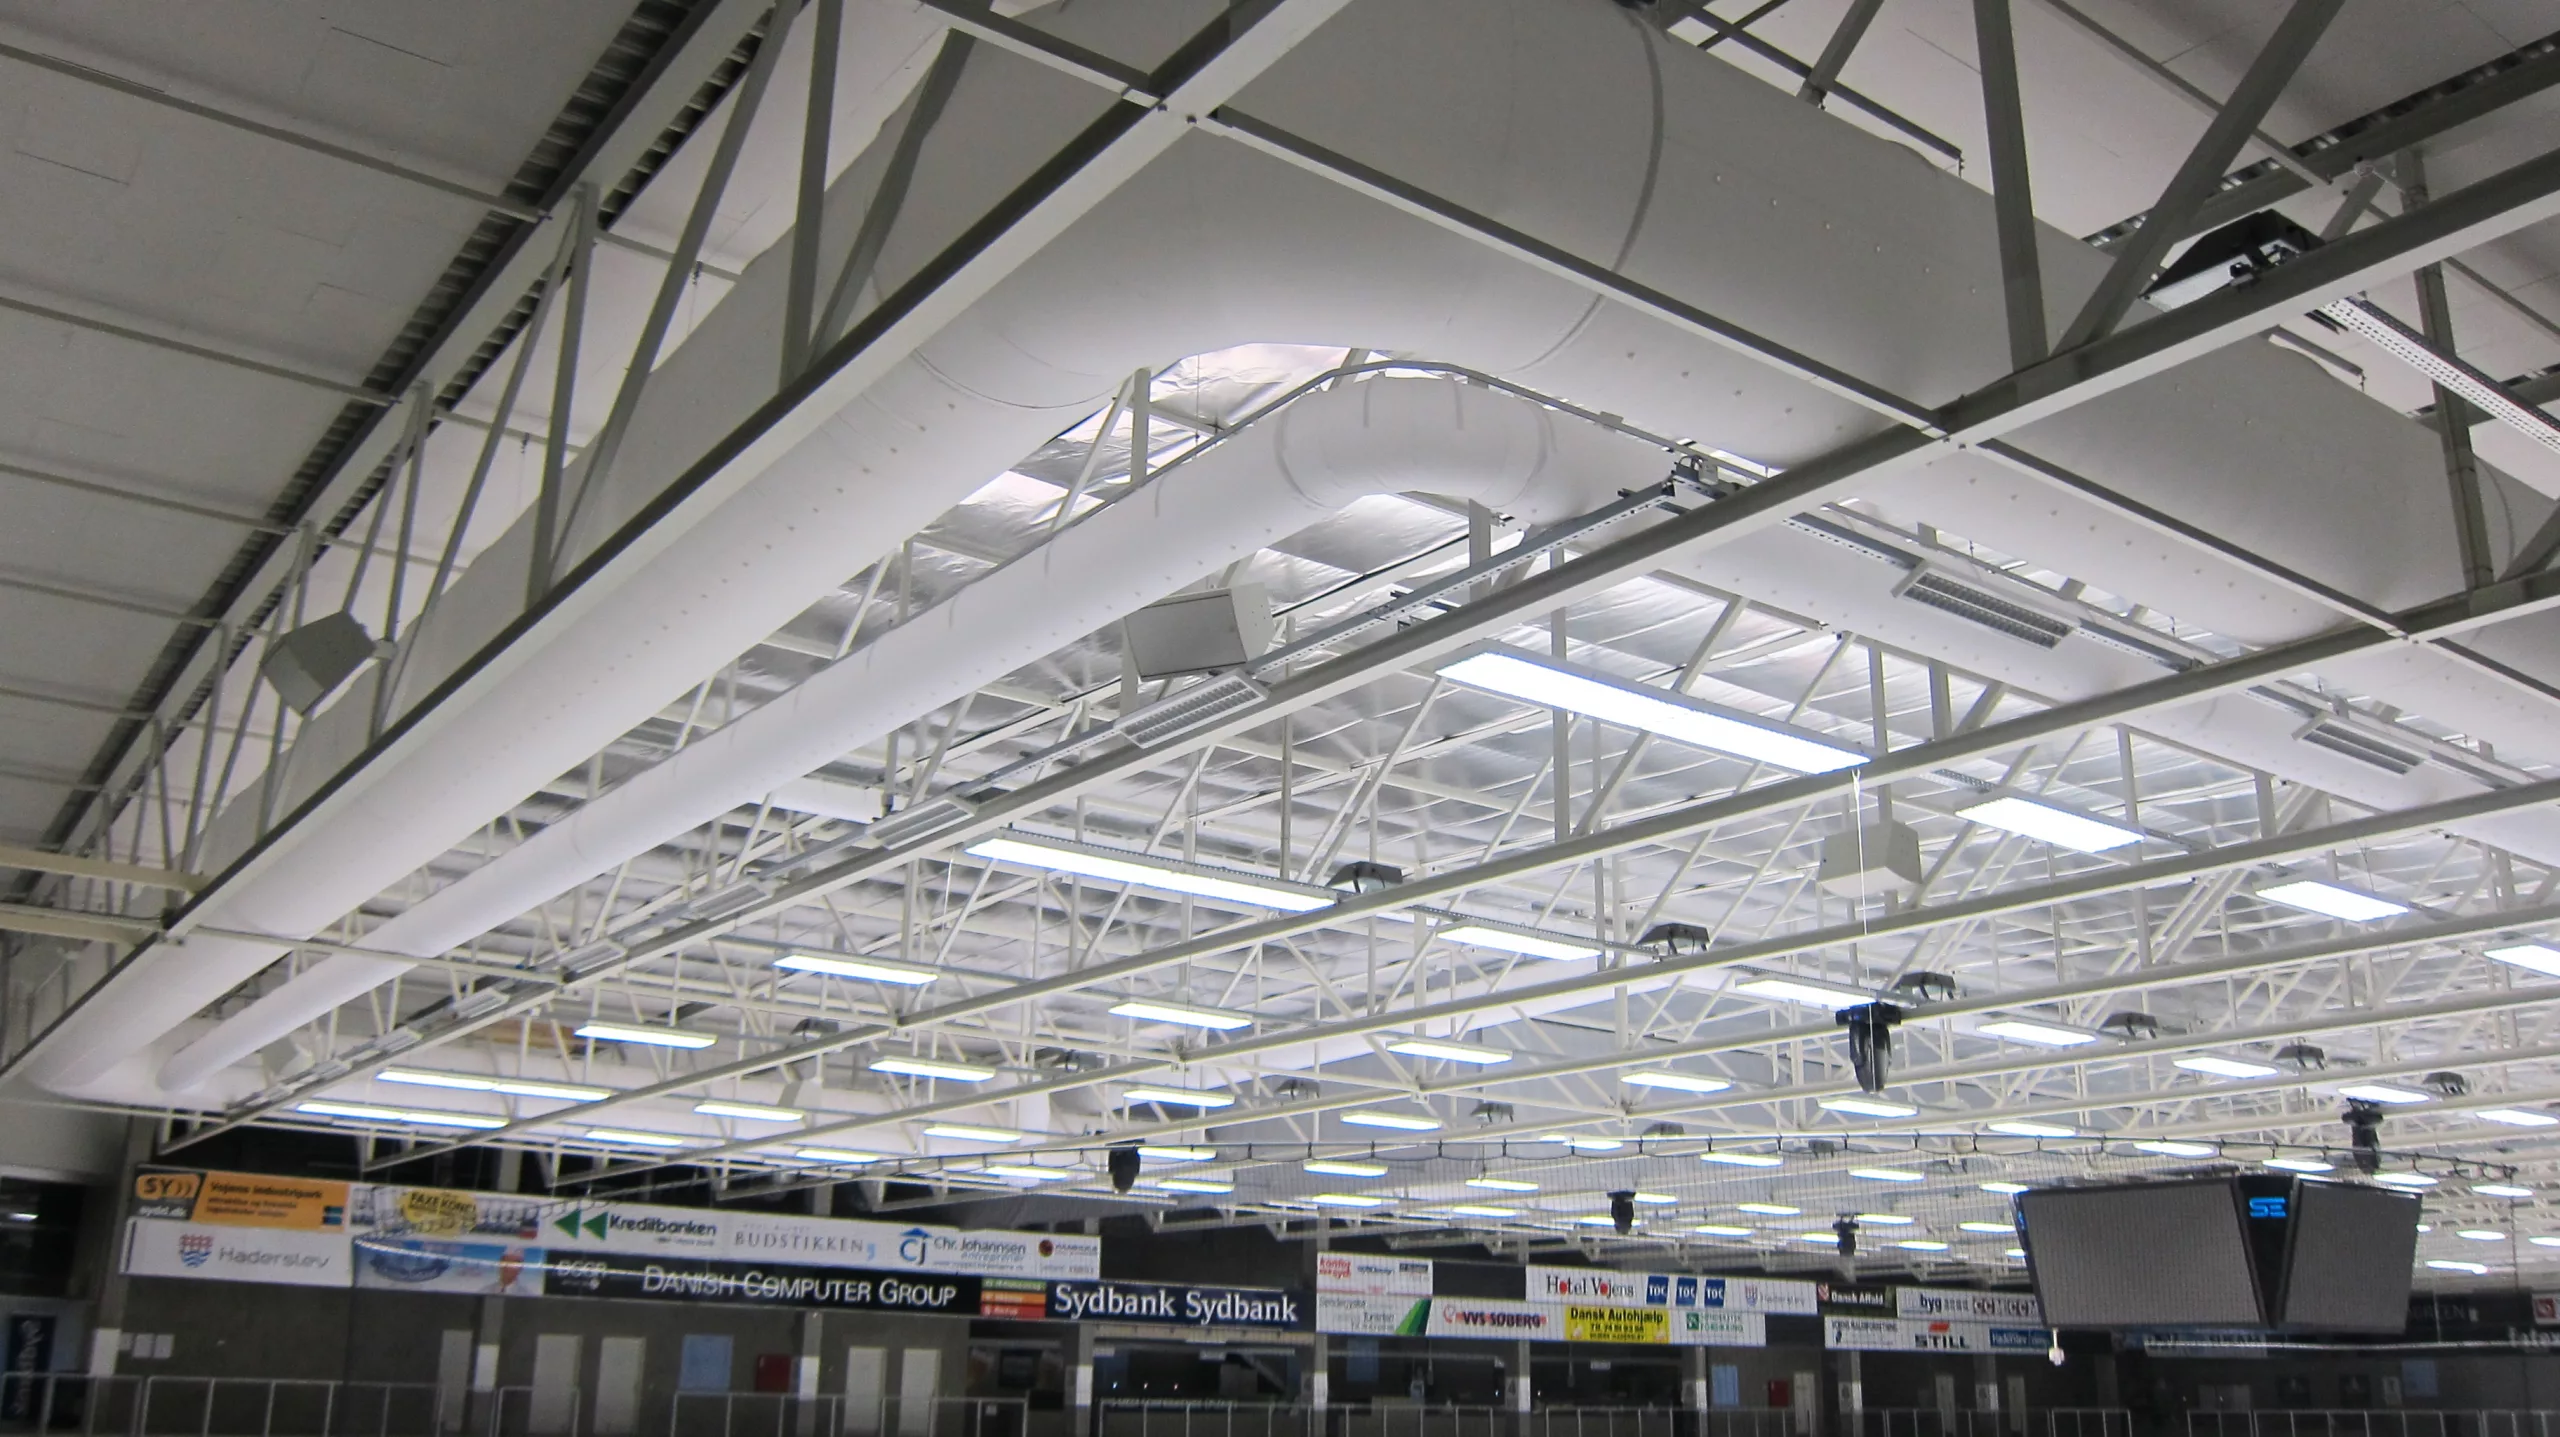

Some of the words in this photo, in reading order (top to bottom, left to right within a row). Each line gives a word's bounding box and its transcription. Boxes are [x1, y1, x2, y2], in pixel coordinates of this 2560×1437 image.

[609, 1214, 717, 1236] Kreditbanken
[933, 1235, 958, 1249] Chr.
[960, 1239, 1026, 1255] Johannsen
[218, 1247, 331, 1269] Haderslev
[642, 1264, 735, 1296] DANISH
[743, 1271, 871, 1304] COMPUTER
[878, 1278, 957, 1307] GROUP
[1546, 1275, 1587, 1296] Hotel
[1591, 1278, 1635, 1298] Vojens
[1054, 1283, 1176, 1320] Sydbank
[1185, 1291, 1298, 1325] Sydbank
[1831, 1292, 1857, 1304] Dansk
[1461, 1311, 1486, 1326] VVS
[1490, 1312, 1541, 1329] SØBERG
[1571, 1308, 1605, 1320] Dansk
[1608, 1309, 1663, 1324] Autohjælp
[1915, 1333, 1969, 1348] STILL
